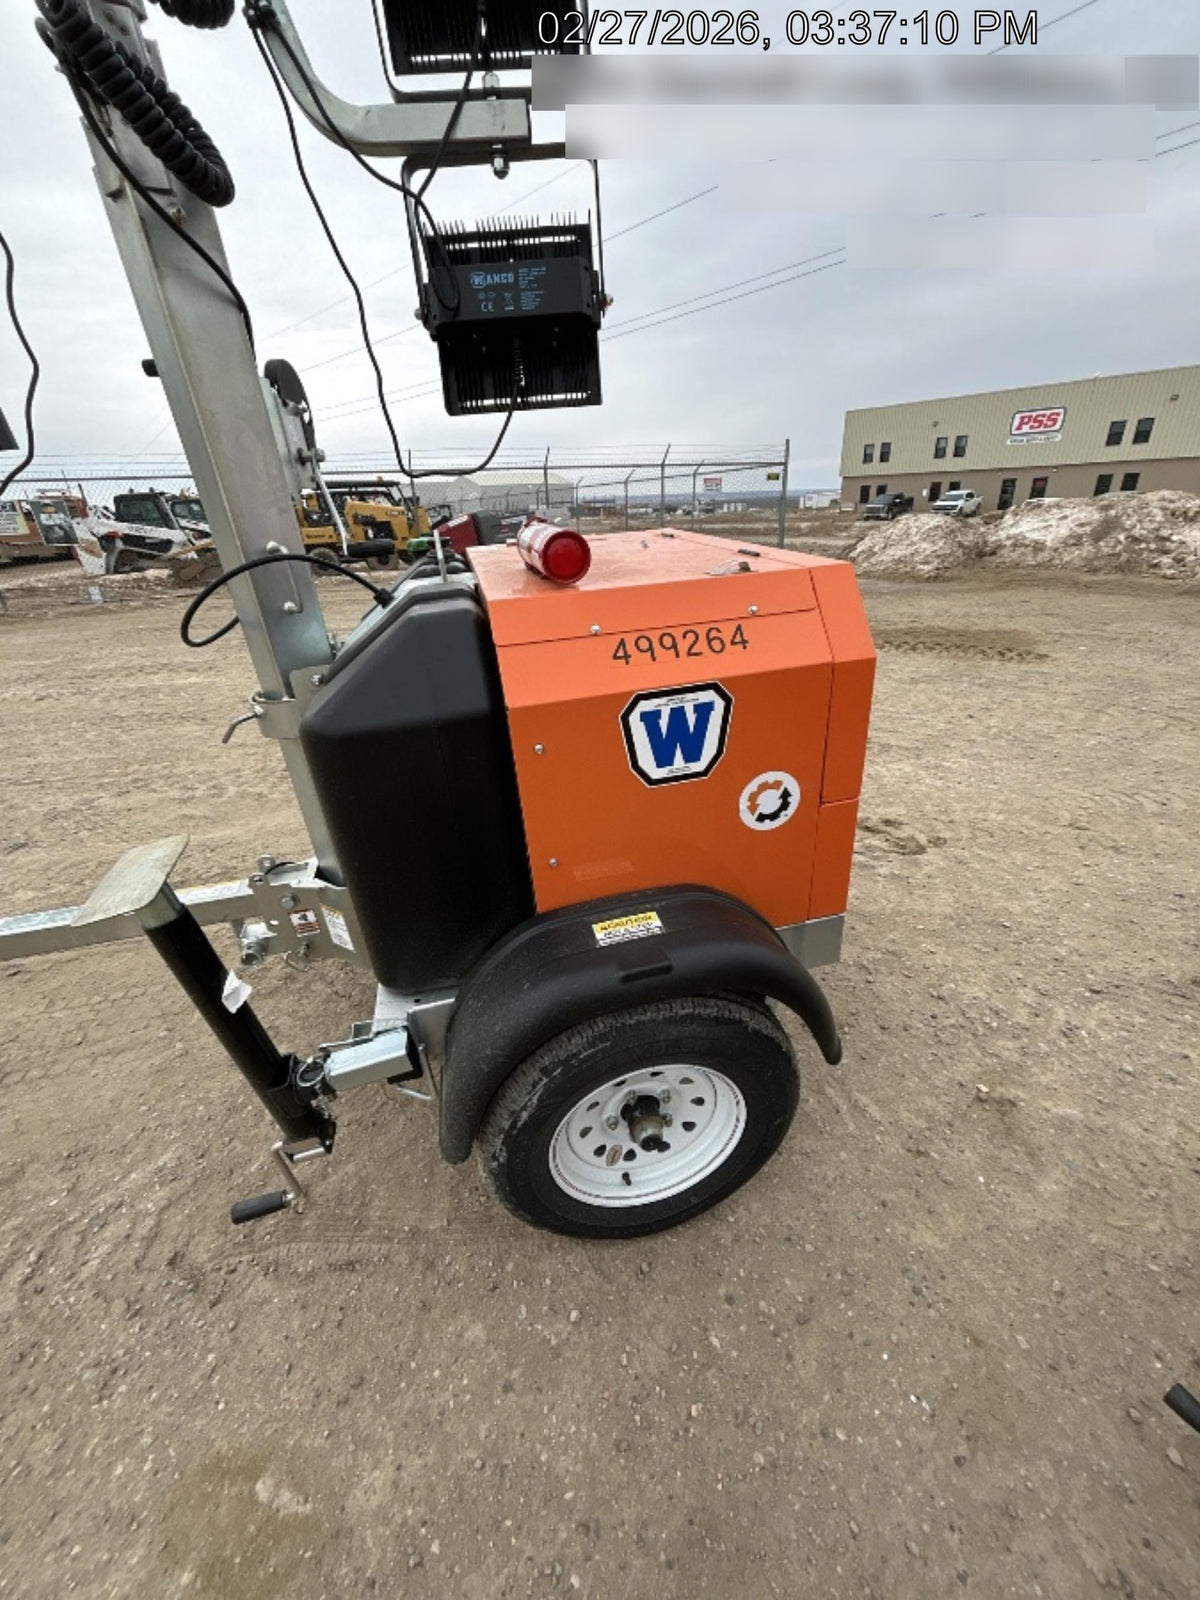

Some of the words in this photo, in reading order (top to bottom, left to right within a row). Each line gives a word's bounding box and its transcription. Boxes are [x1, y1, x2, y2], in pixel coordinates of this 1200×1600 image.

[1014, 412, 1062, 431] PSS
[612, 623, 749, 665] 499264
[640, 700, 715, 769] W
